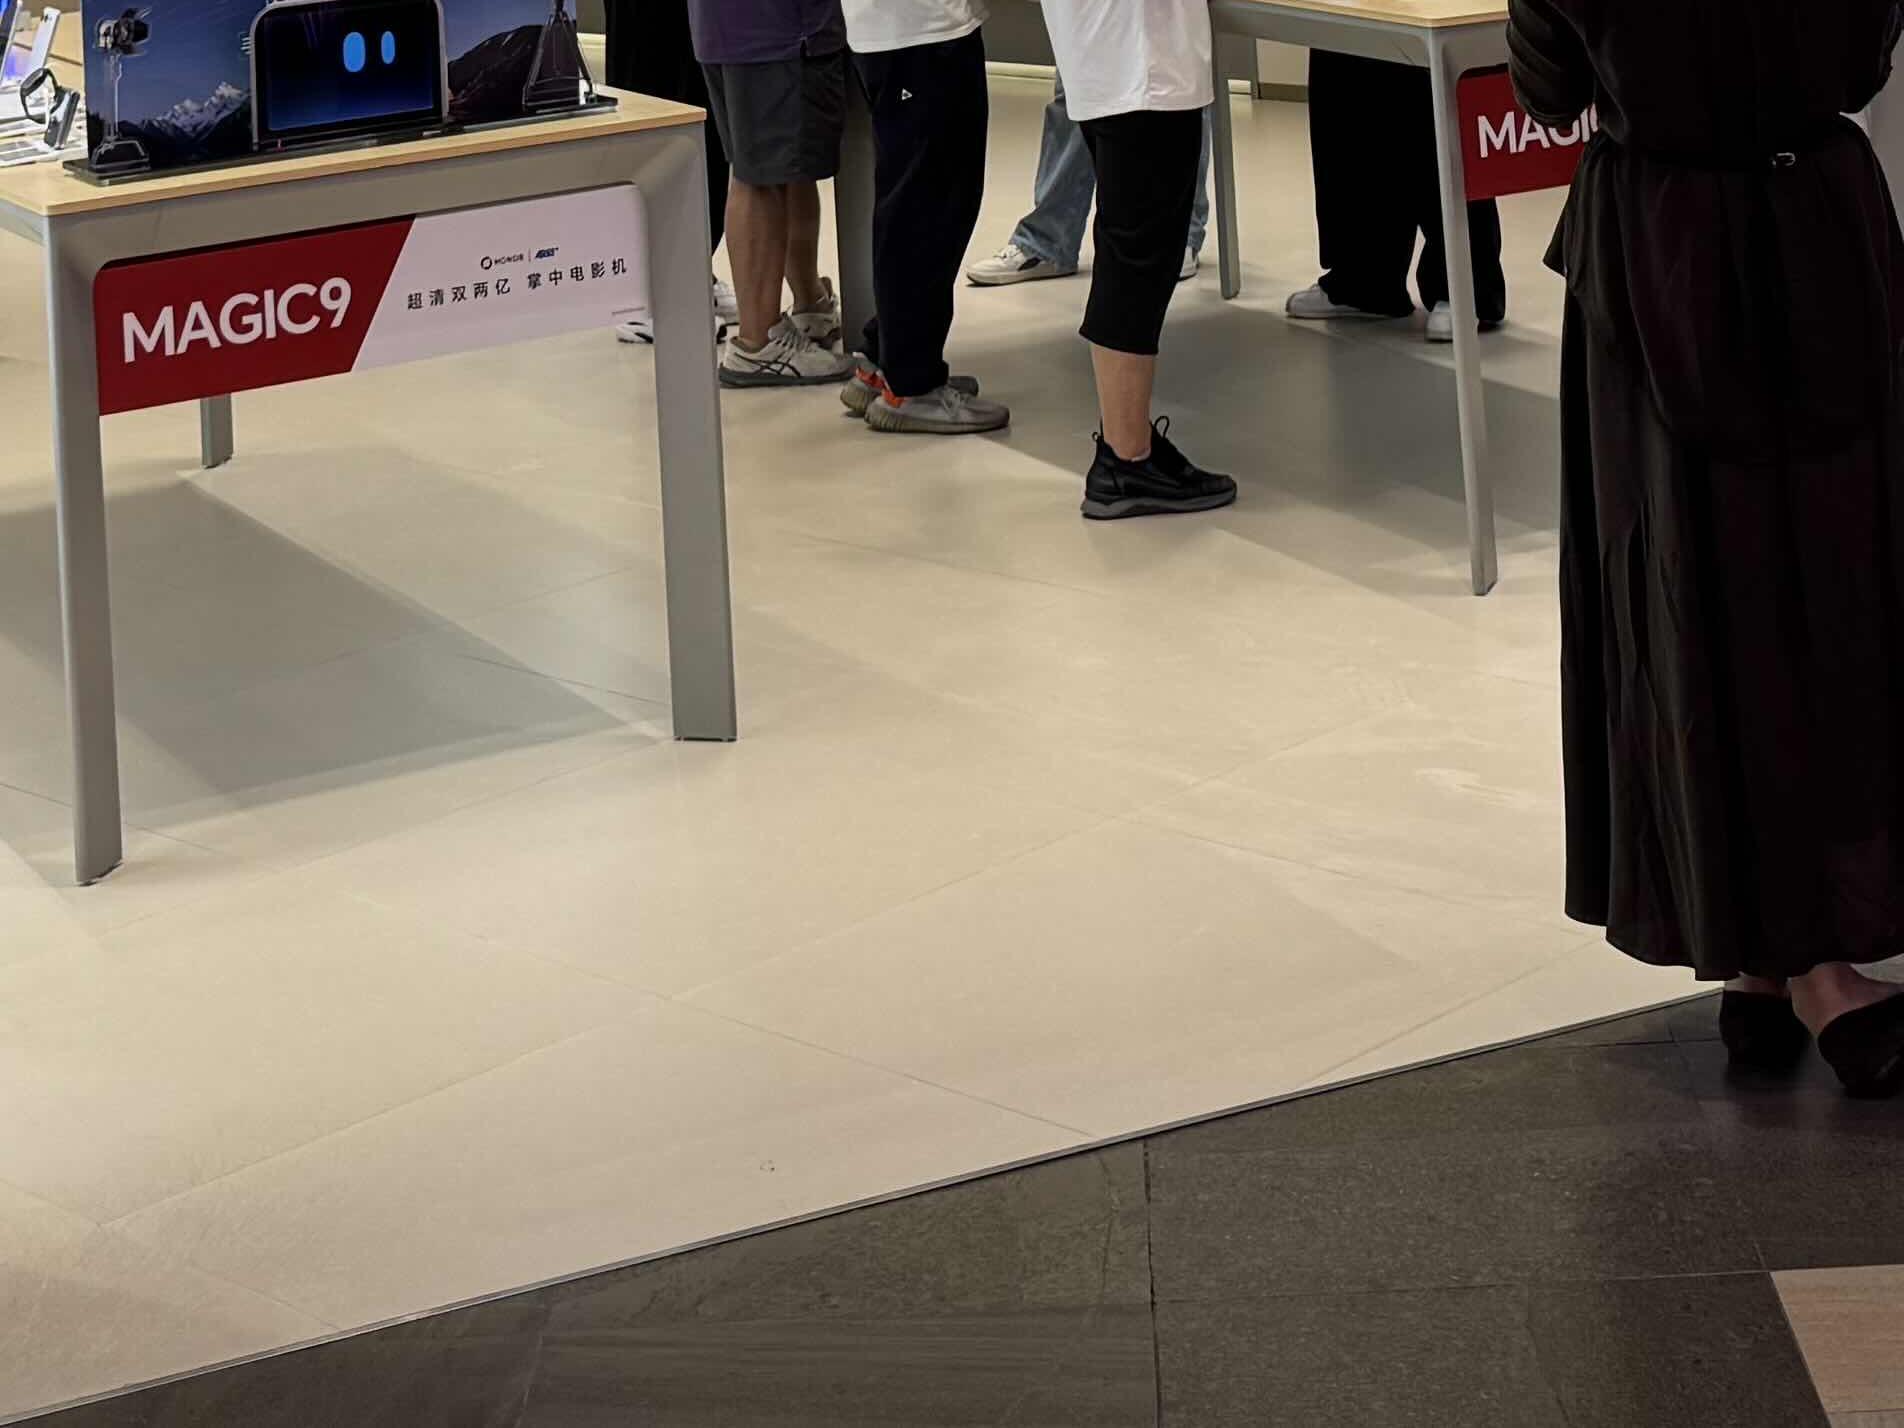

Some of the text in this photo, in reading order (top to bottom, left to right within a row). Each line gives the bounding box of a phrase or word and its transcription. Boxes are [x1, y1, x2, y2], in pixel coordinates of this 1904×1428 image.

[122, 276, 352, 363] MAGIC9
[407, 259, 628, 311] 超清双两亿 掌中电影机
